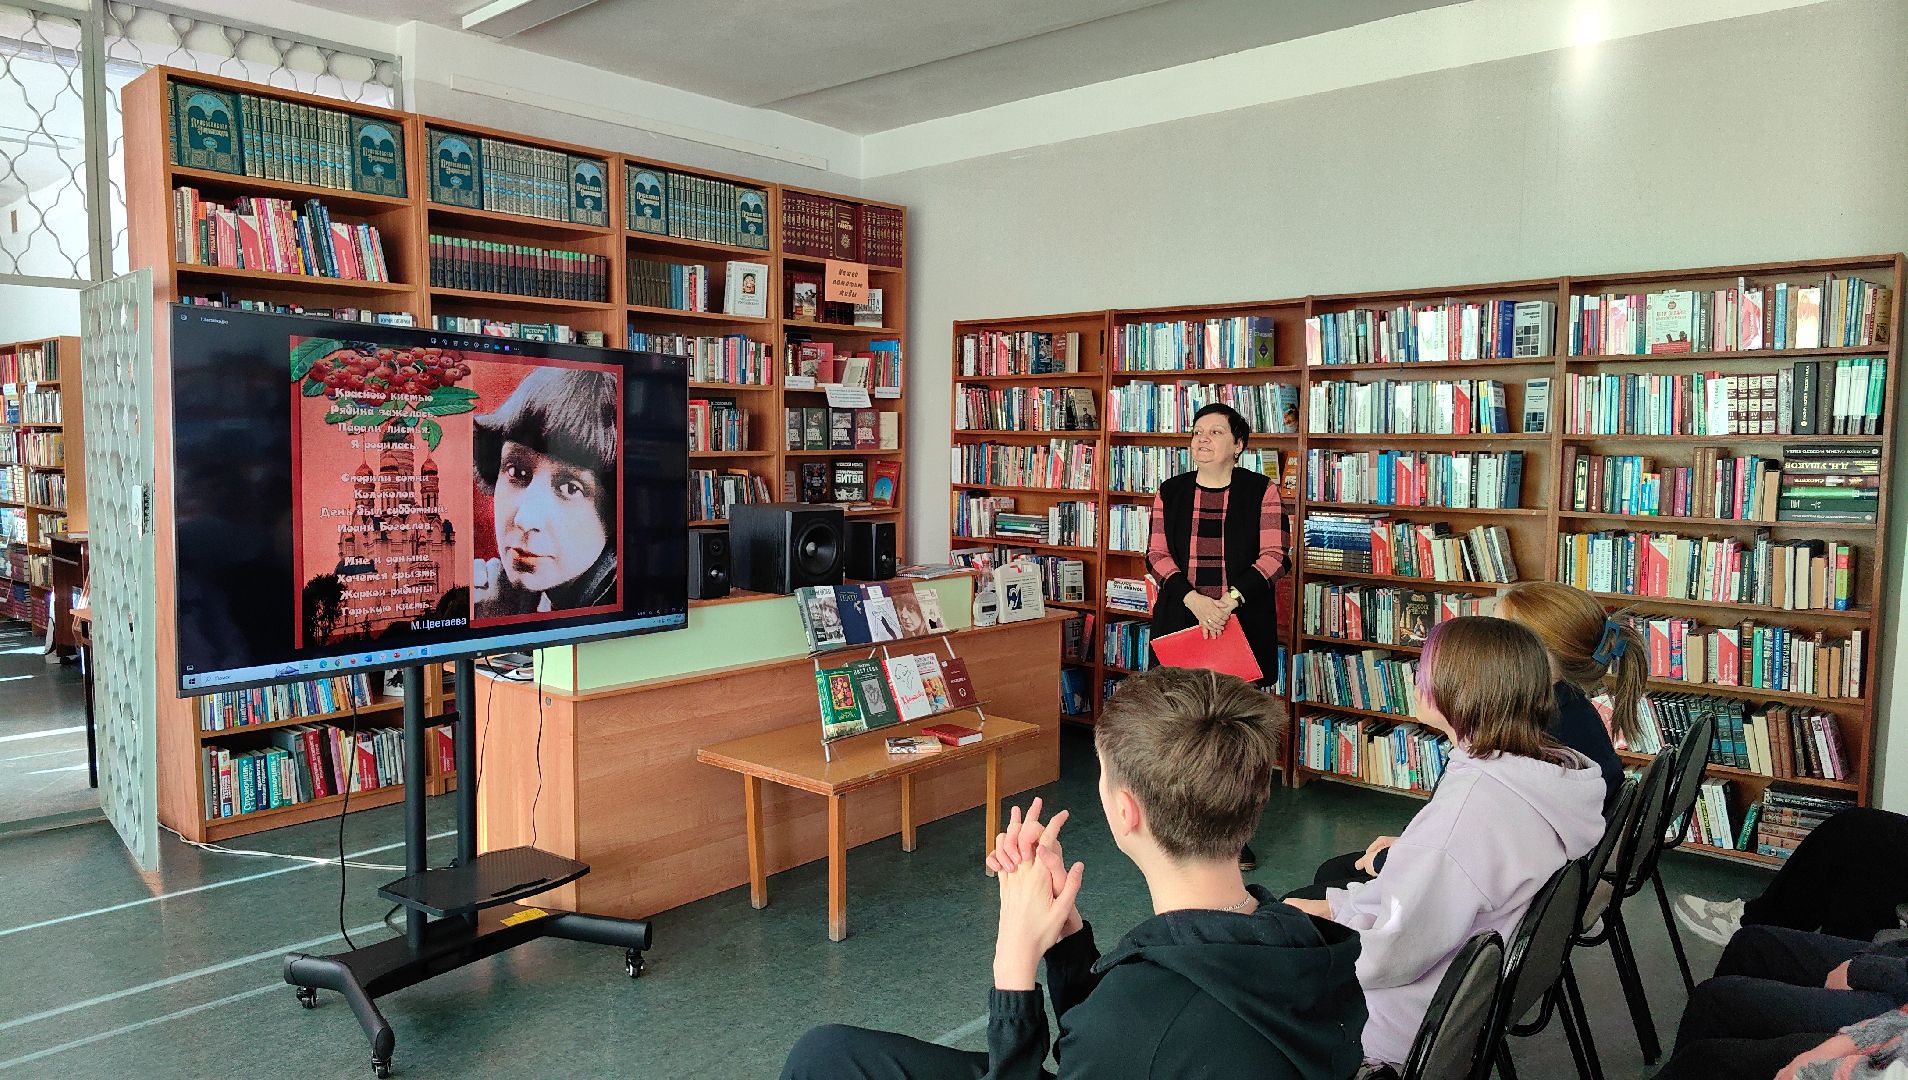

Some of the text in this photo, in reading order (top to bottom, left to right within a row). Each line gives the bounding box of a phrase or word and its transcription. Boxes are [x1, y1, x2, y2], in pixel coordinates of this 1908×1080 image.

[335, 388, 434, 402] Красною кистью
[330, 404, 374, 416] Рябина
[338, 422, 382, 434] Падали
[351, 440, 420, 450] Я родилась.
[1784, 462, 1849, 470] Д.Н. УШАКОВ
[341, 473, 392, 484] Спорили
[835, 474, 864, 484] БИТВА
[320, 506, 353, 518] День
[356, 504, 382, 517] был
[337, 523, 374, 533] Иоанн
[344, 556, 371, 566] Мне
[386, 554, 430, 565] доныне
[337, 569, 437, 584] Хочется грызть
[340, 584, 433, 600] Жаркой рябины
[341, 605, 392, 618] Горькую
[410, 618, 467, 631] М.Цветаева
